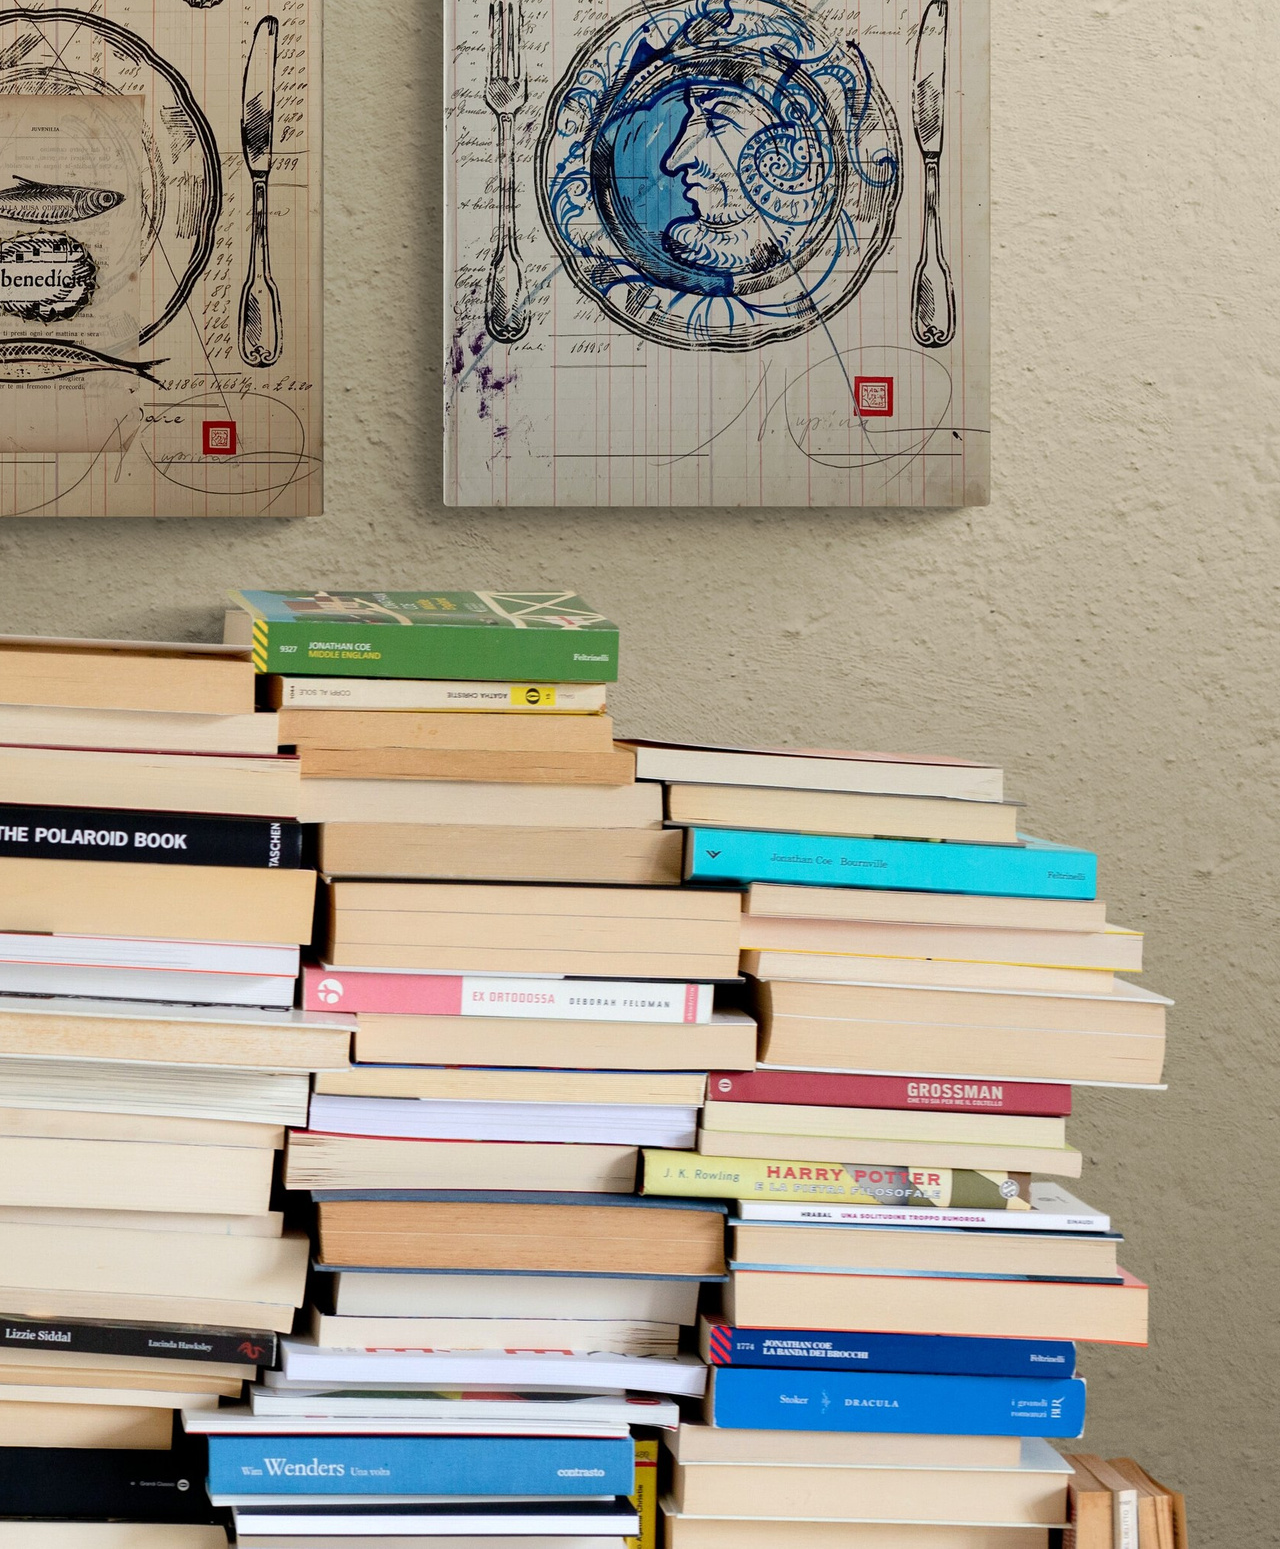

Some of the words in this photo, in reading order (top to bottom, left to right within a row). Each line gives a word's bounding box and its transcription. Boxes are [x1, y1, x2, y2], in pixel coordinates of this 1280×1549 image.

[279, 645, 297, 653] 9327
[308, 641, 351, 650] JONATHAN
[353, 643, 371, 651] COE
[308, 650, 339, 659] MIDDLE
[341, 651, 381, 660] ENGLAND
[573, 653, 609, 663] Feltrinelli
[35, 827, 128, 847] POLAROID
[134, 832, 187, 850] BOOK
[268, 822, 281, 868] TASCHEN
[771, 853, 812, 865] Jonathan
[815, 855, 833, 865] Coe
[840, 857, 888, 869] Bournville
[1047, 870, 1085, 881] Feltrinelli
[473, 991, 485, 1003] EX
[489, 991, 556, 1005] ORTODOSSA
[569, 997, 616, 1007] DEBORAH
[623, 999, 671, 1008] FELDMAN
[908, 1083, 1003, 1099] GROSSMAN
[663, 1168, 672, 1178] J.
[679, 1169, 689, 1179] K.
[695, 1170, 740, 1182] Rowling
[767, 1166, 843, 1181] HARRY
[854, 1170, 941, 1186] POTTER
[770, 1183, 787, 1192] LA
[793, 1184, 845, 1194] PIETRA
[851, 1186, 941, 1199] FILOSOFALE
[800, 1211, 832, 1219] HRABAL
[841, 1212, 858, 1220] UNA
[860, 1212, 906, 1221] SOLITUDINE
[908, 1213, 940, 1222] TROPPO
[943, 1214, 986, 1223] RUMOROSA
[5, 1328, 35, 1342] Lizzie
[37, 1330, 71, 1343] Siddal
[148, 1339, 176, 1349] Lucinda
[178, 1341, 213, 1353] Hawksley
[763, 1340, 812, 1349] JONATHAN
[827, 1350, 868, 1359] BROCCHI
[1030, 1354, 1065, 1363] Feltrinelli
[779, 1394, 808, 1405] Stoker
[844, 1398, 899, 1408] DRACULA
[241, 1466, 262, 1476] Wim
[264, 1458, 345, 1477] Wenders
[350, 1467, 368, 1476] Una
[369, 1467, 390, 1476] volta
[557, 1467, 605, 1477] contrasto
